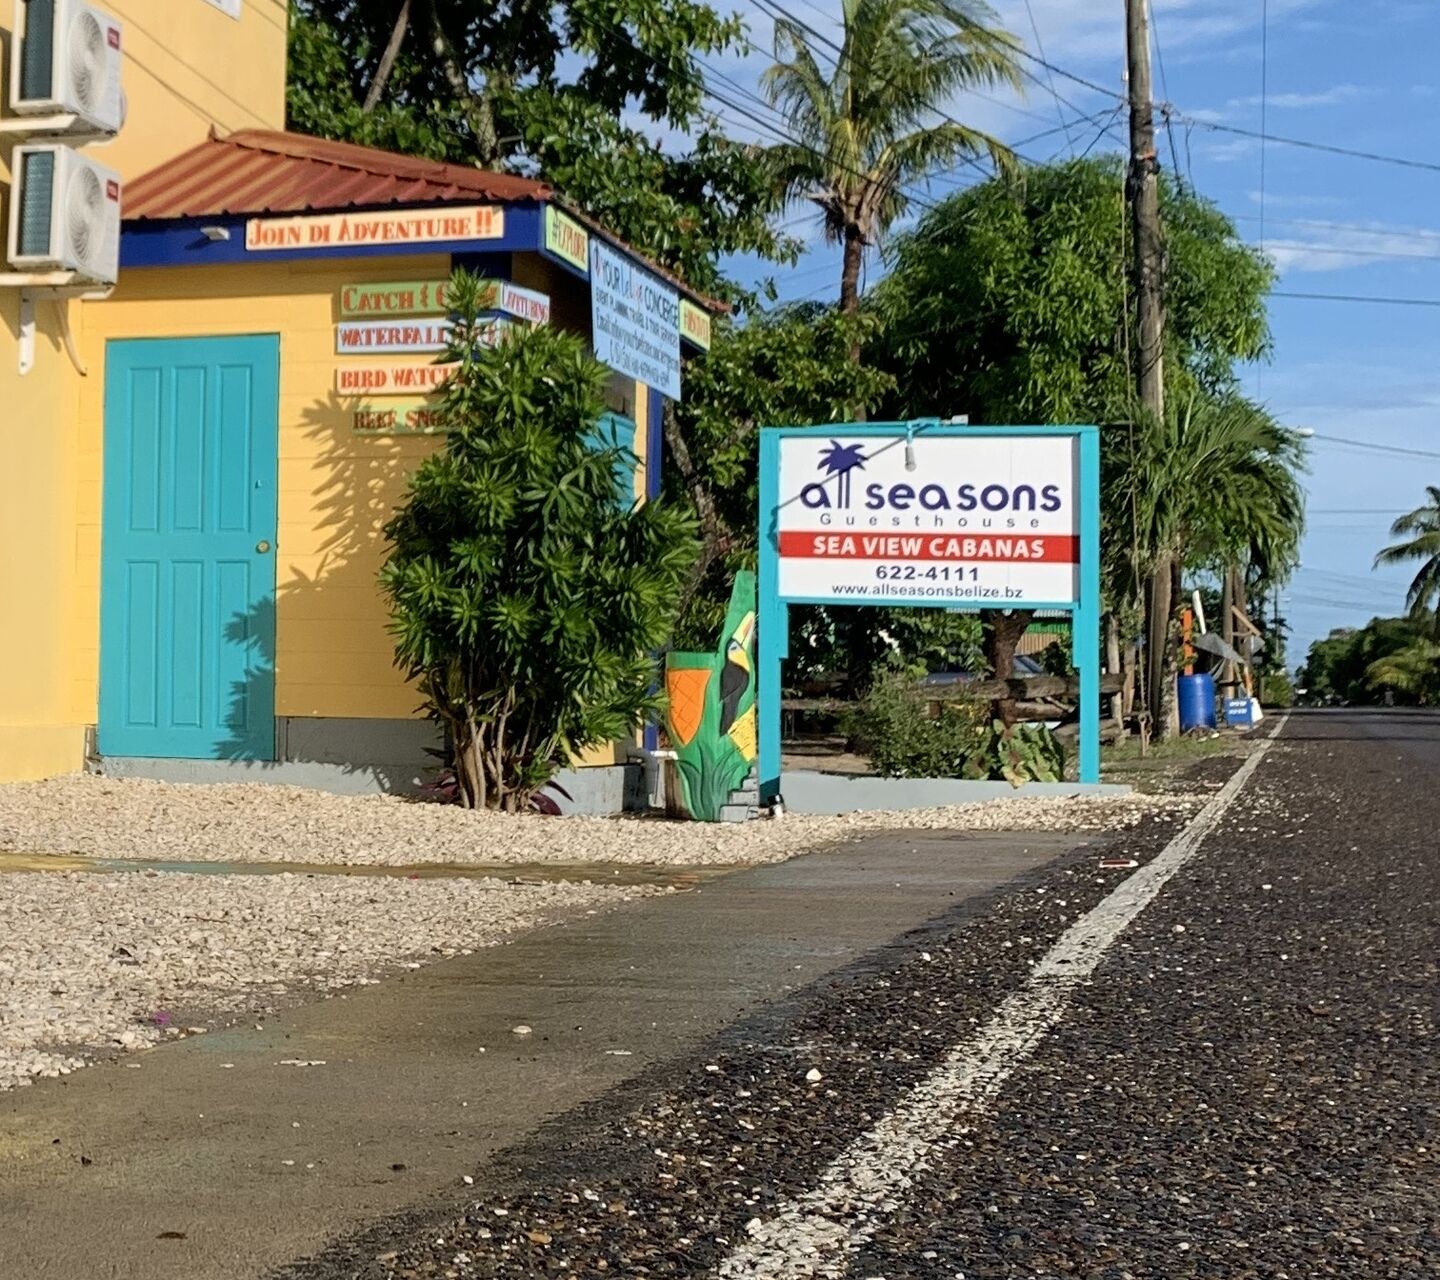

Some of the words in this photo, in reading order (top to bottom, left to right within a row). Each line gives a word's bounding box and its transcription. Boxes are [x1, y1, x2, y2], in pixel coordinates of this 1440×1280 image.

[248, 218, 301, 247] JOIN
[338, 216, 472, 242] ADVENTURE
[343, 286, 414, 312] CATCH
[341, 370, 387, 389] BIRD
[865, 482, 1062, 512] seasons
[820, 512, 1040, 528] Guesthouse
[813, 535, 857, 556] SEA
[863, 536, 923, 557] VIEW
[929, 537, 1045, 559] CABANAS
[875, 565, 979, 582] 622-4111
[831, 584, 1023, 599] www.allseasonsbelize.bz
